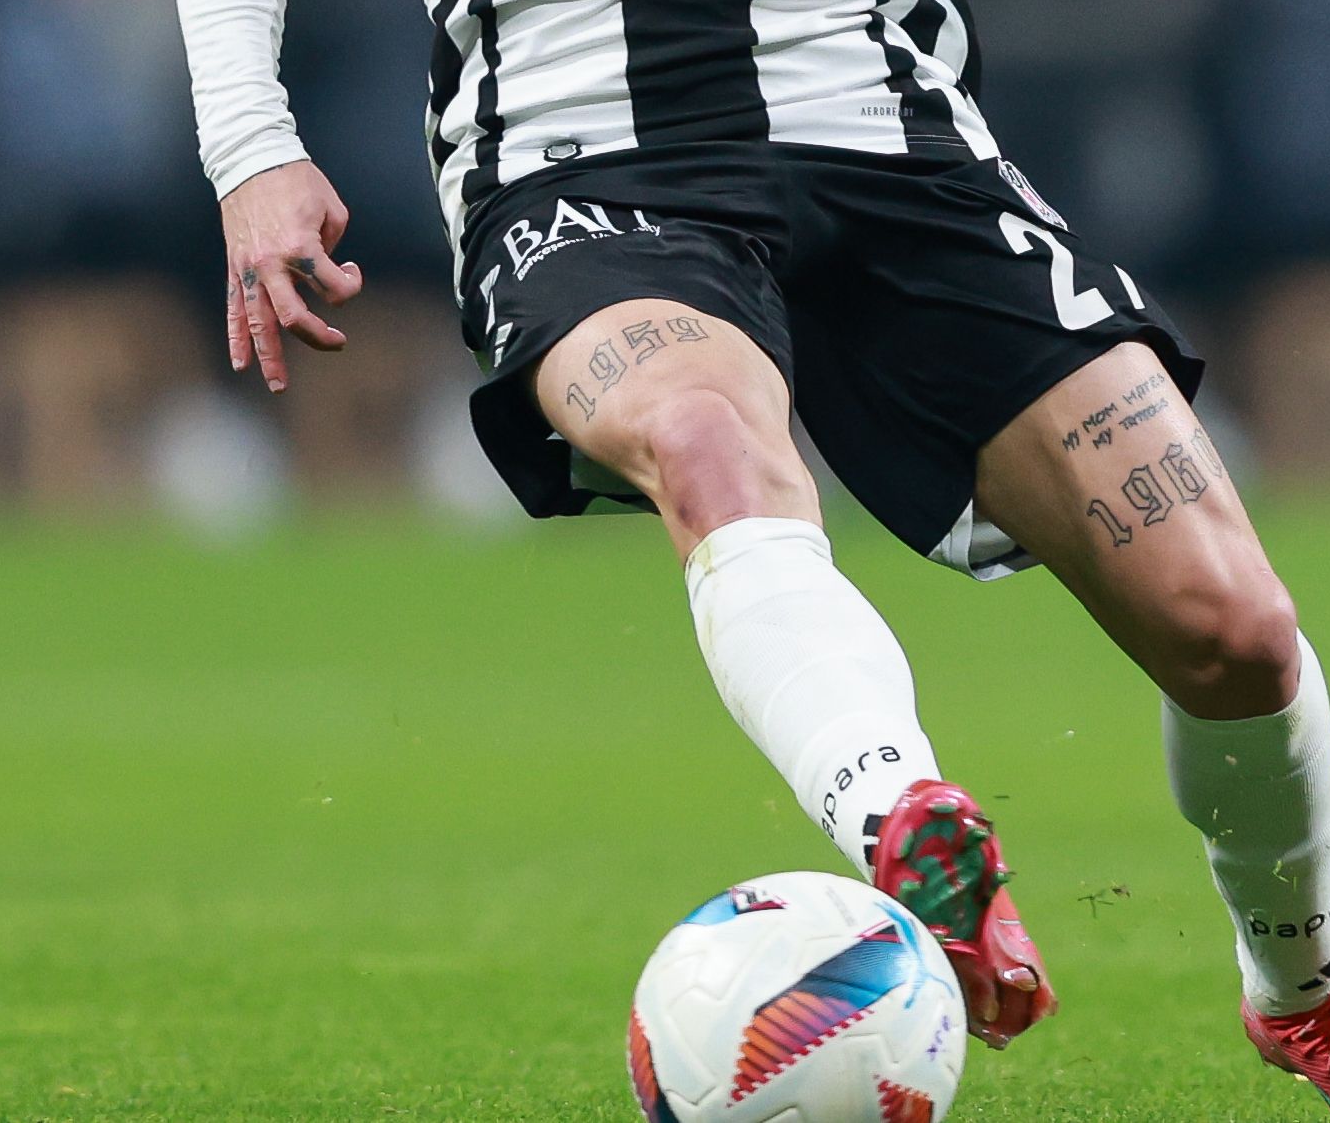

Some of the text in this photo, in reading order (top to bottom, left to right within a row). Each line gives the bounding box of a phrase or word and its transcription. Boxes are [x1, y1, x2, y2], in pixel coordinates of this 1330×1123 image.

[998, 211, 1146, 330] 2
[566, 317, 709, 423] 1959
[1082, 402, 1118, 434] MOM
[821, 745, 901, 841] apara
